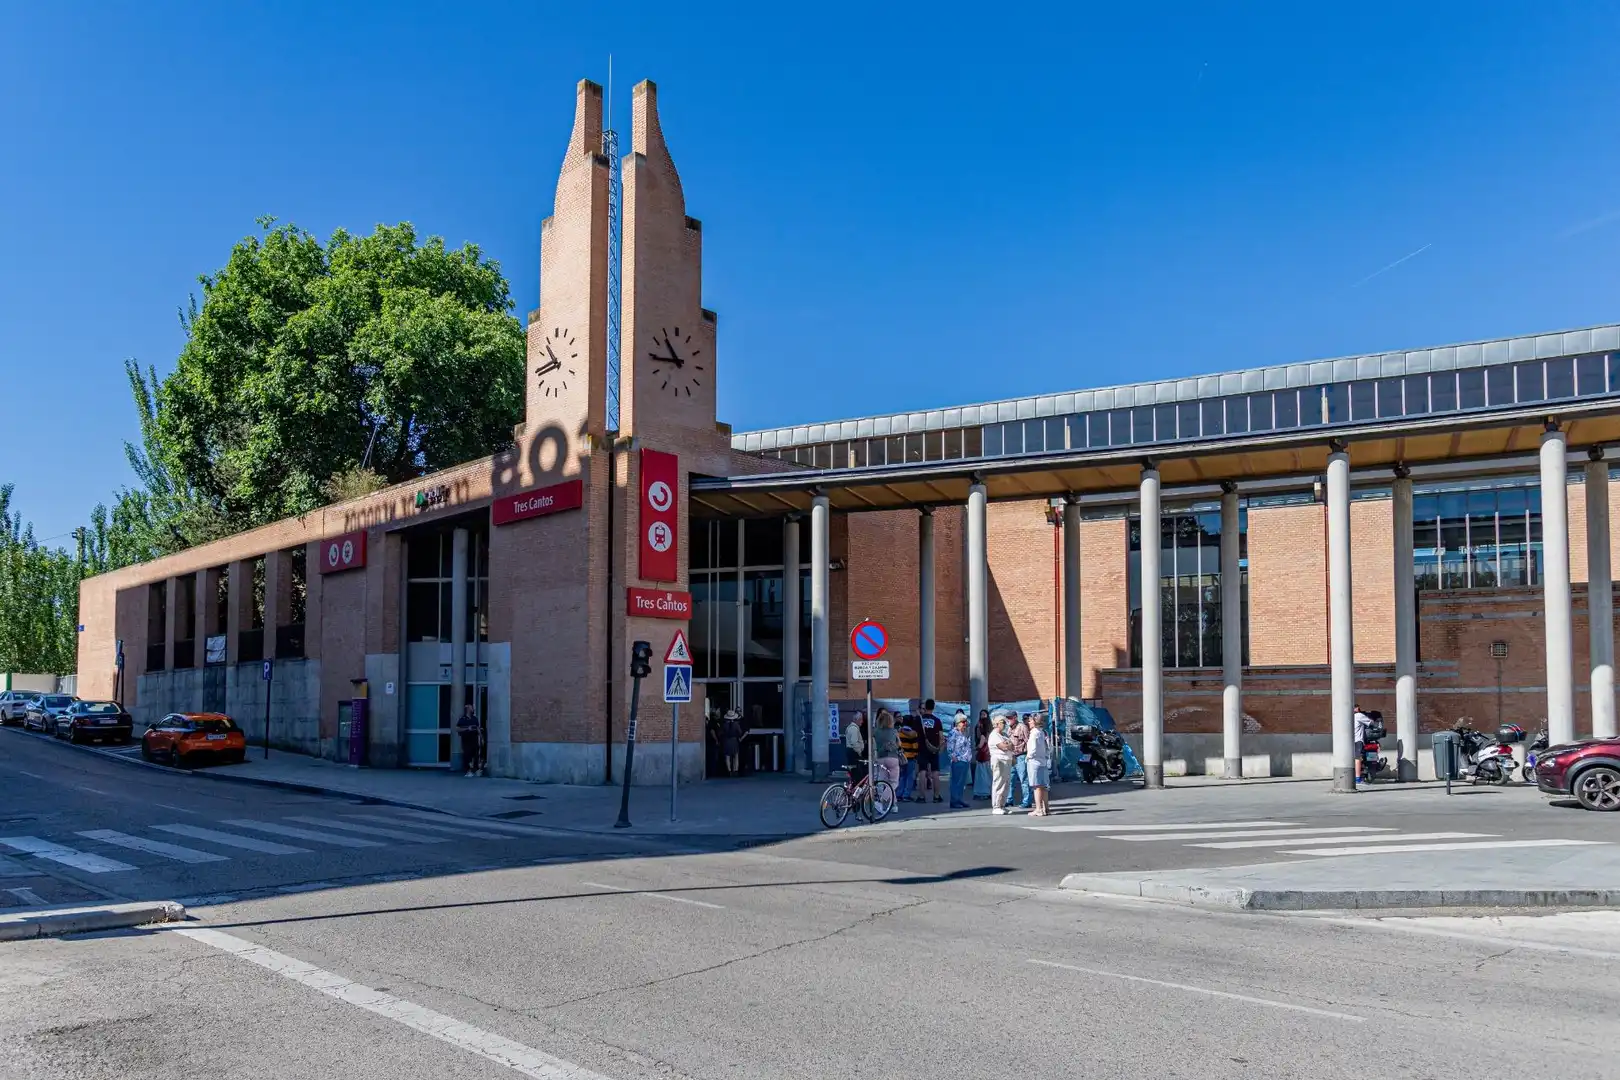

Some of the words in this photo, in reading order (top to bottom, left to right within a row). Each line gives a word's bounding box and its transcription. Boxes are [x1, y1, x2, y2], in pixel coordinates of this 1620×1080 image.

[513, 501, 527, 513] Tres
[529, 495, 553, 510] Cantos
[636, 595, 655, 609] Tres
[656, 598, 688, 612] Cantos
